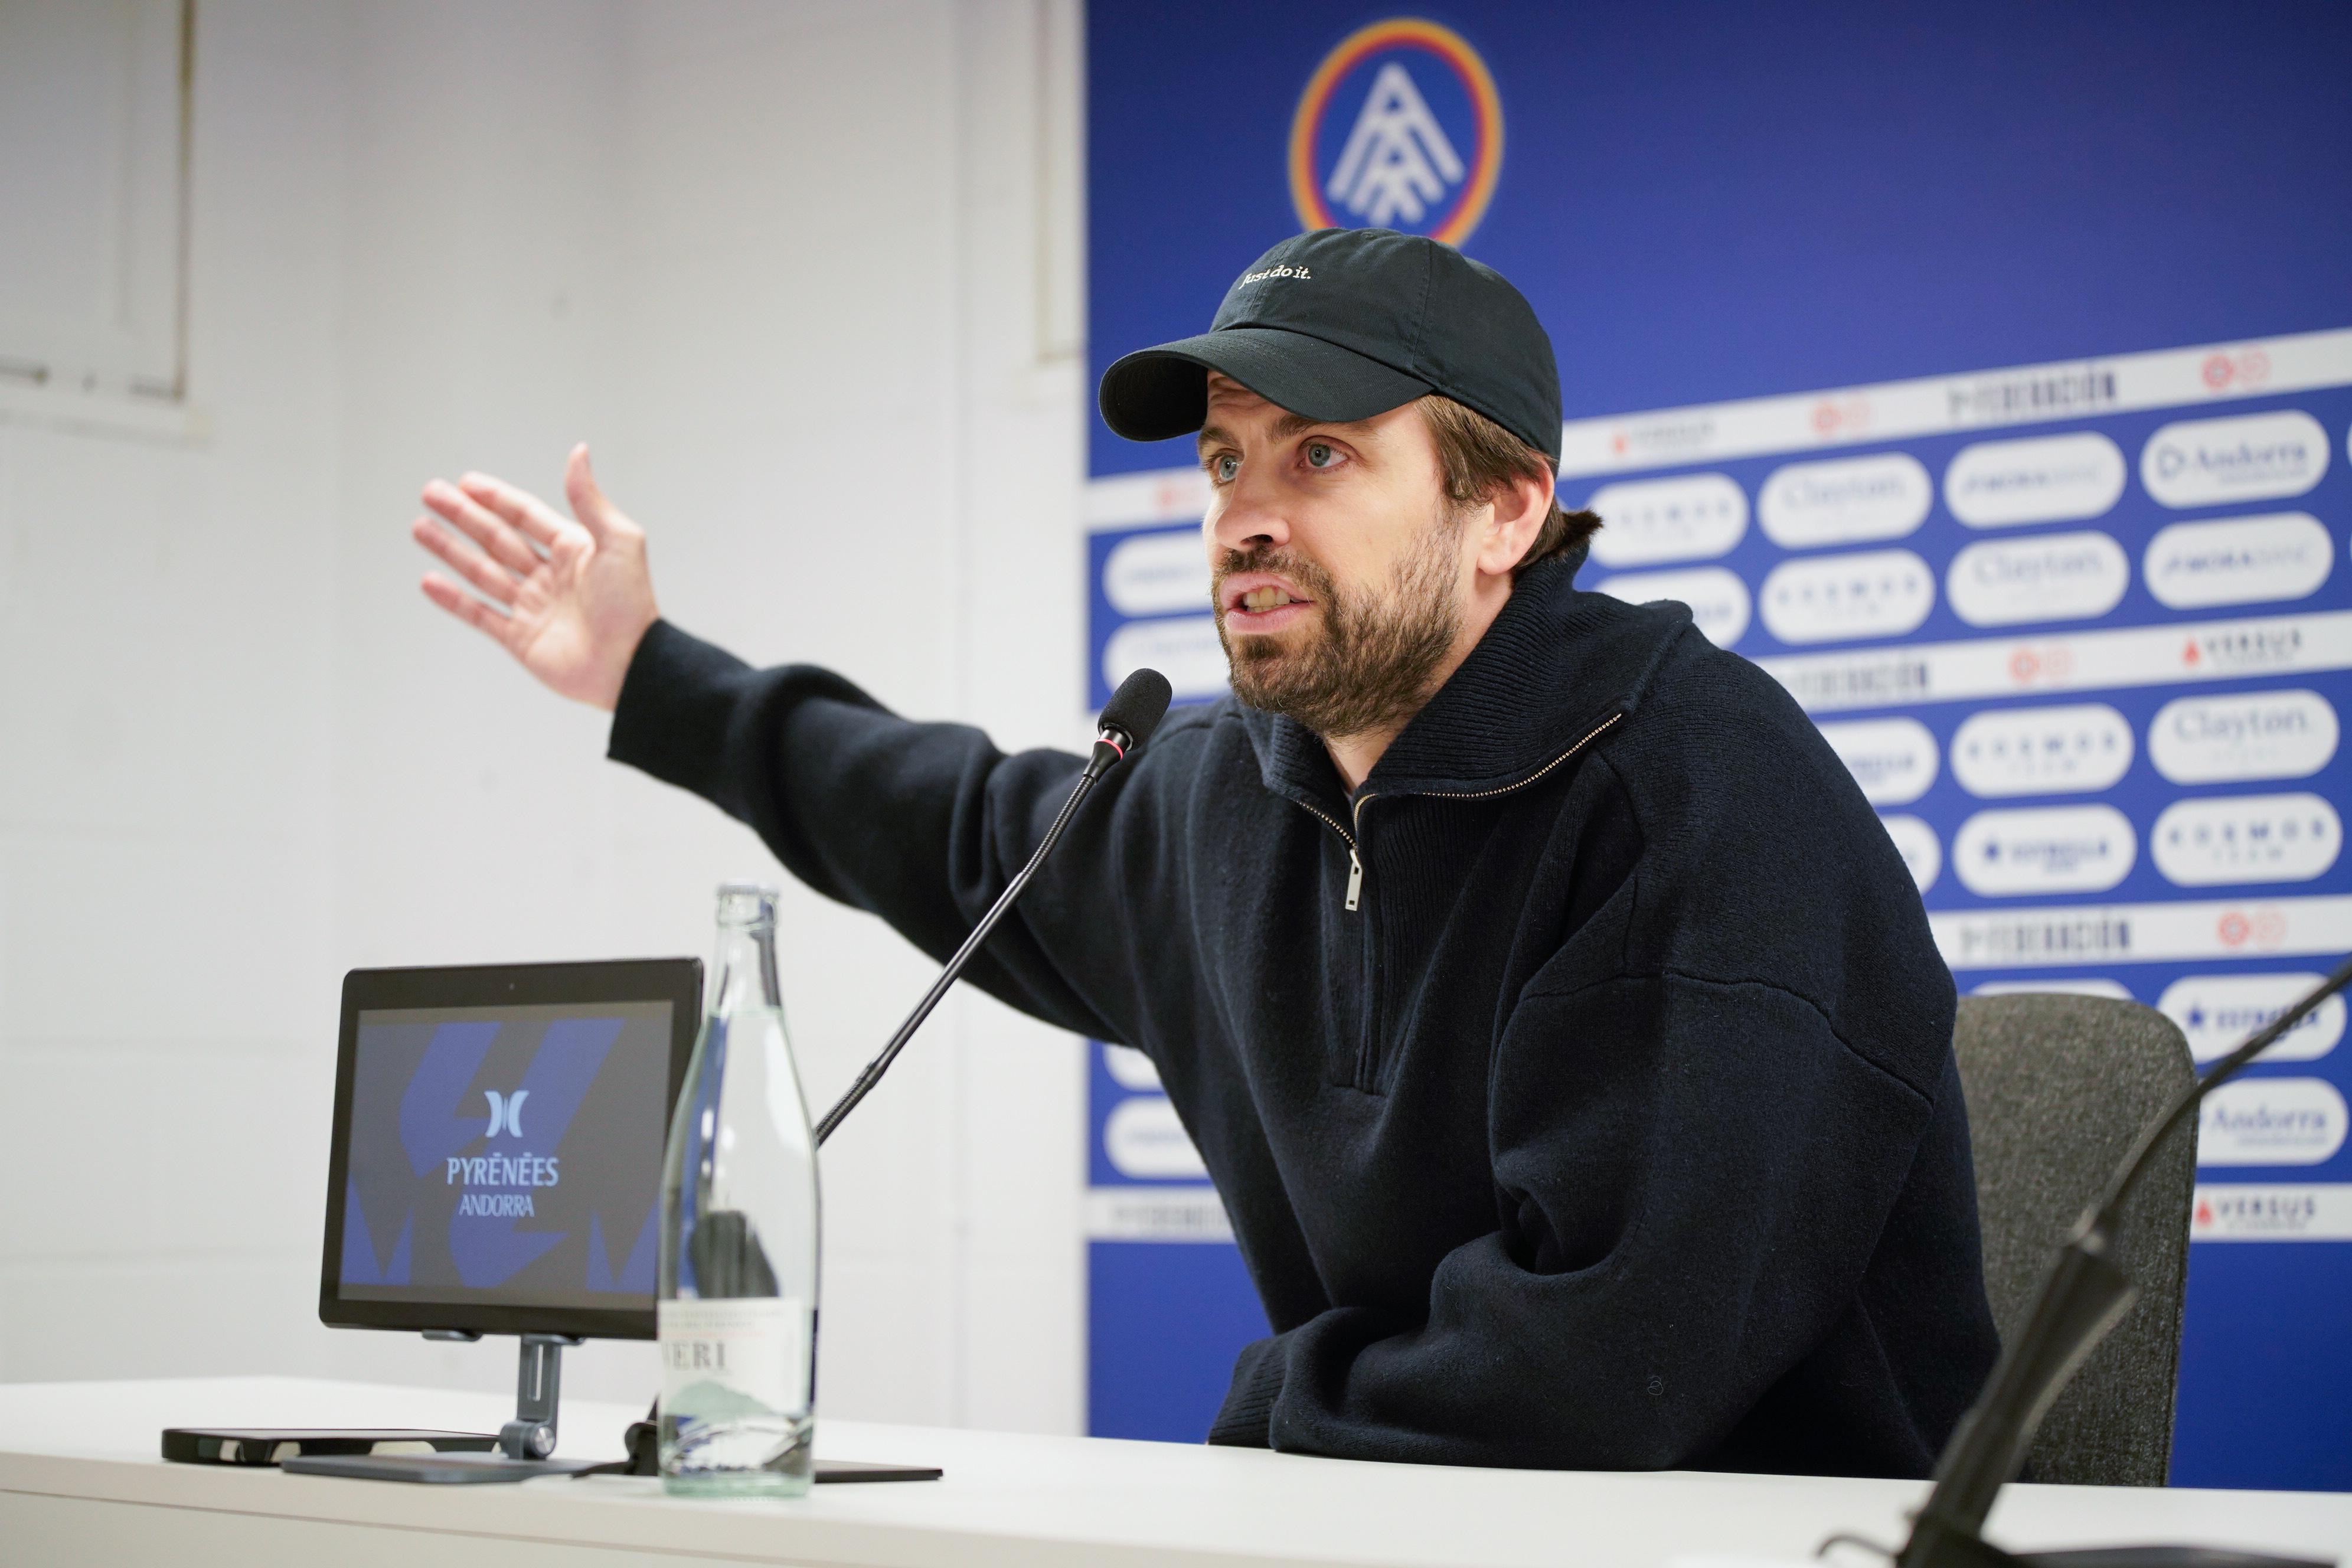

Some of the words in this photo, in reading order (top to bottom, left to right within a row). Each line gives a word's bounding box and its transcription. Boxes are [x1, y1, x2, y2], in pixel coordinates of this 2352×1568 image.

[1238, 269, 1270, 290] Just
[1270, 264, 1292, 277] do
[1293, 266, 1311, 279] it.
[2174, 706, 2307, 746] Clayton
[2210, 1104, 2327, 1132] Andorra
[459, 1194, 535, 1217] ANDORRA
[2219, 1198, 2315, 1217] VERSUS
